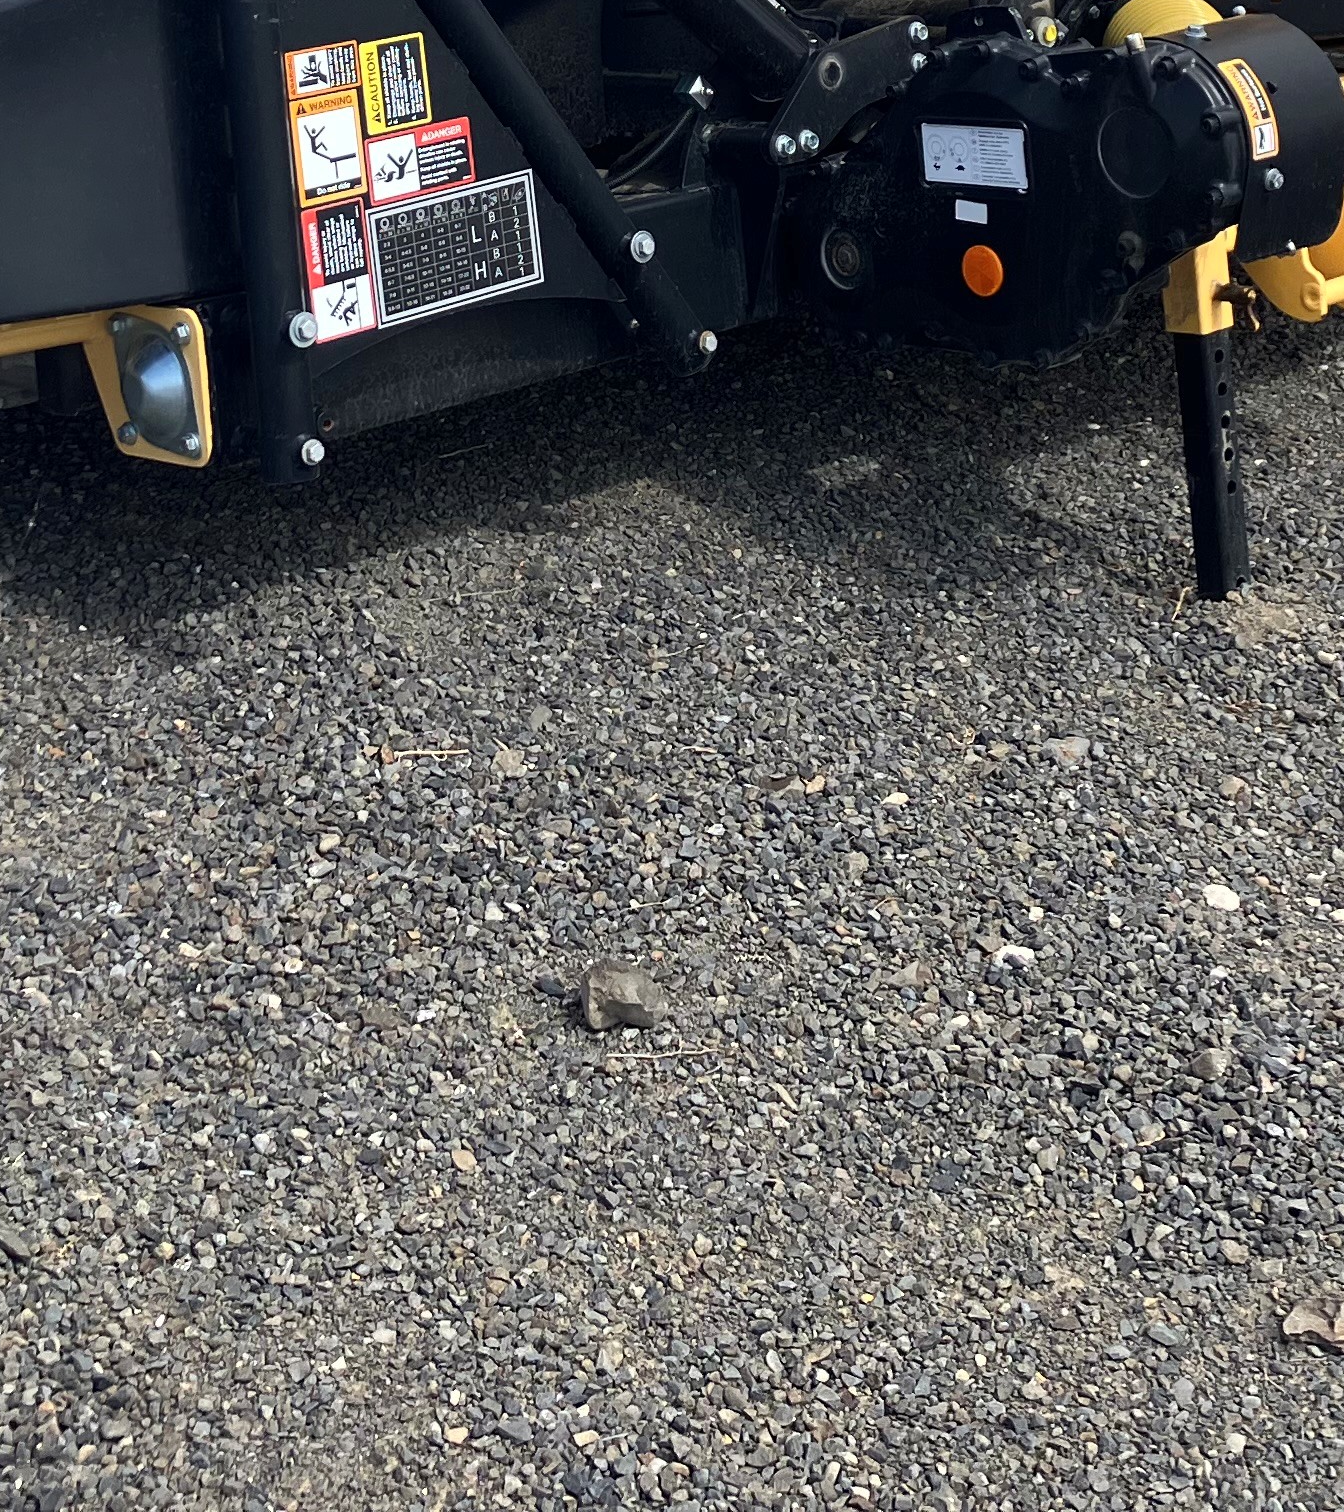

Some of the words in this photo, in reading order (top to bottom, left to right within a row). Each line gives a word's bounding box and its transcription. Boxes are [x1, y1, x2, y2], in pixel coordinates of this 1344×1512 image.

[366, 51, 381, 115] CAUTION
[308, 94, 353, 112] WARNING
[427, 124, 462, 140] DANGER
[471, 226, 482, 243] L
[474, 260, 487, 280] H
